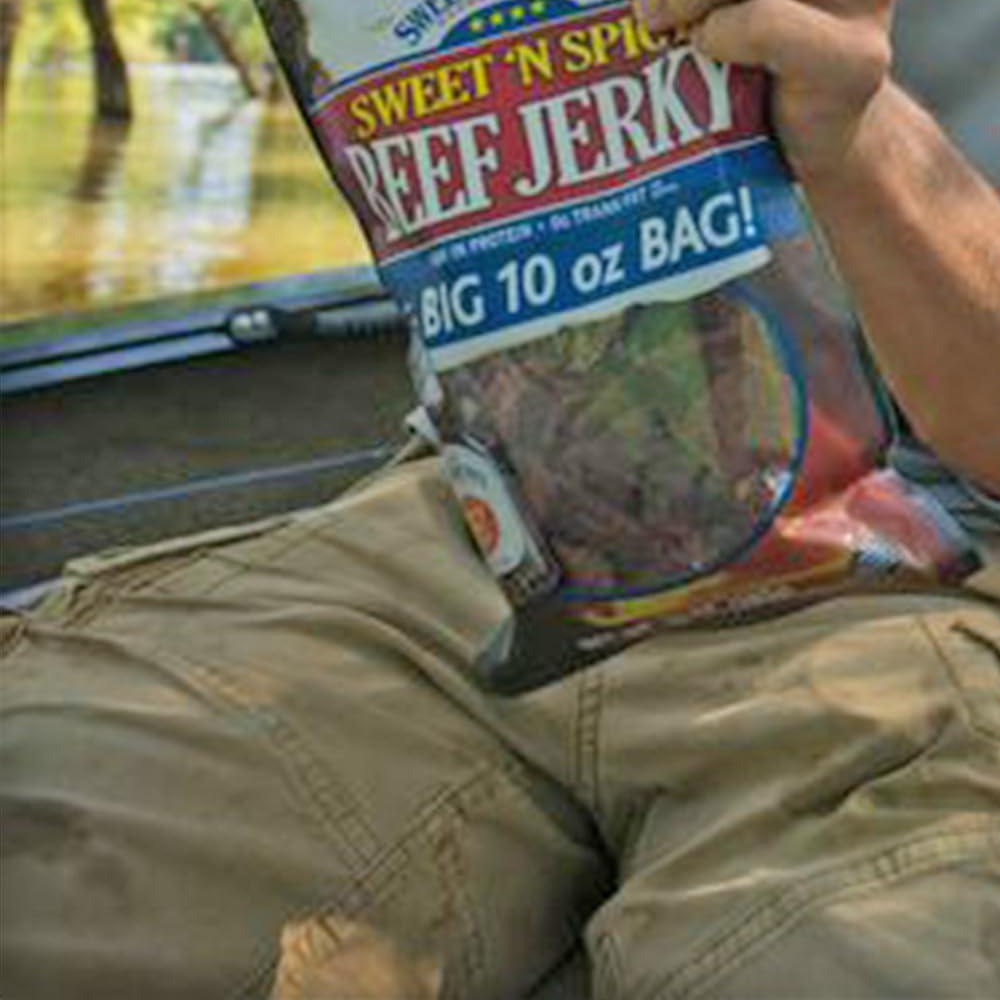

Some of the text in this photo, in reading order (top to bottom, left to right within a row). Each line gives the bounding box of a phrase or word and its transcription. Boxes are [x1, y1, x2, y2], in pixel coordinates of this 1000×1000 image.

[345, 46, 732, 240] BEEF JERKY
[350, 16, 668, 139] SWEET 'N SPIC
[420, 185, 757, 339] BIG 10 oz BAG!
